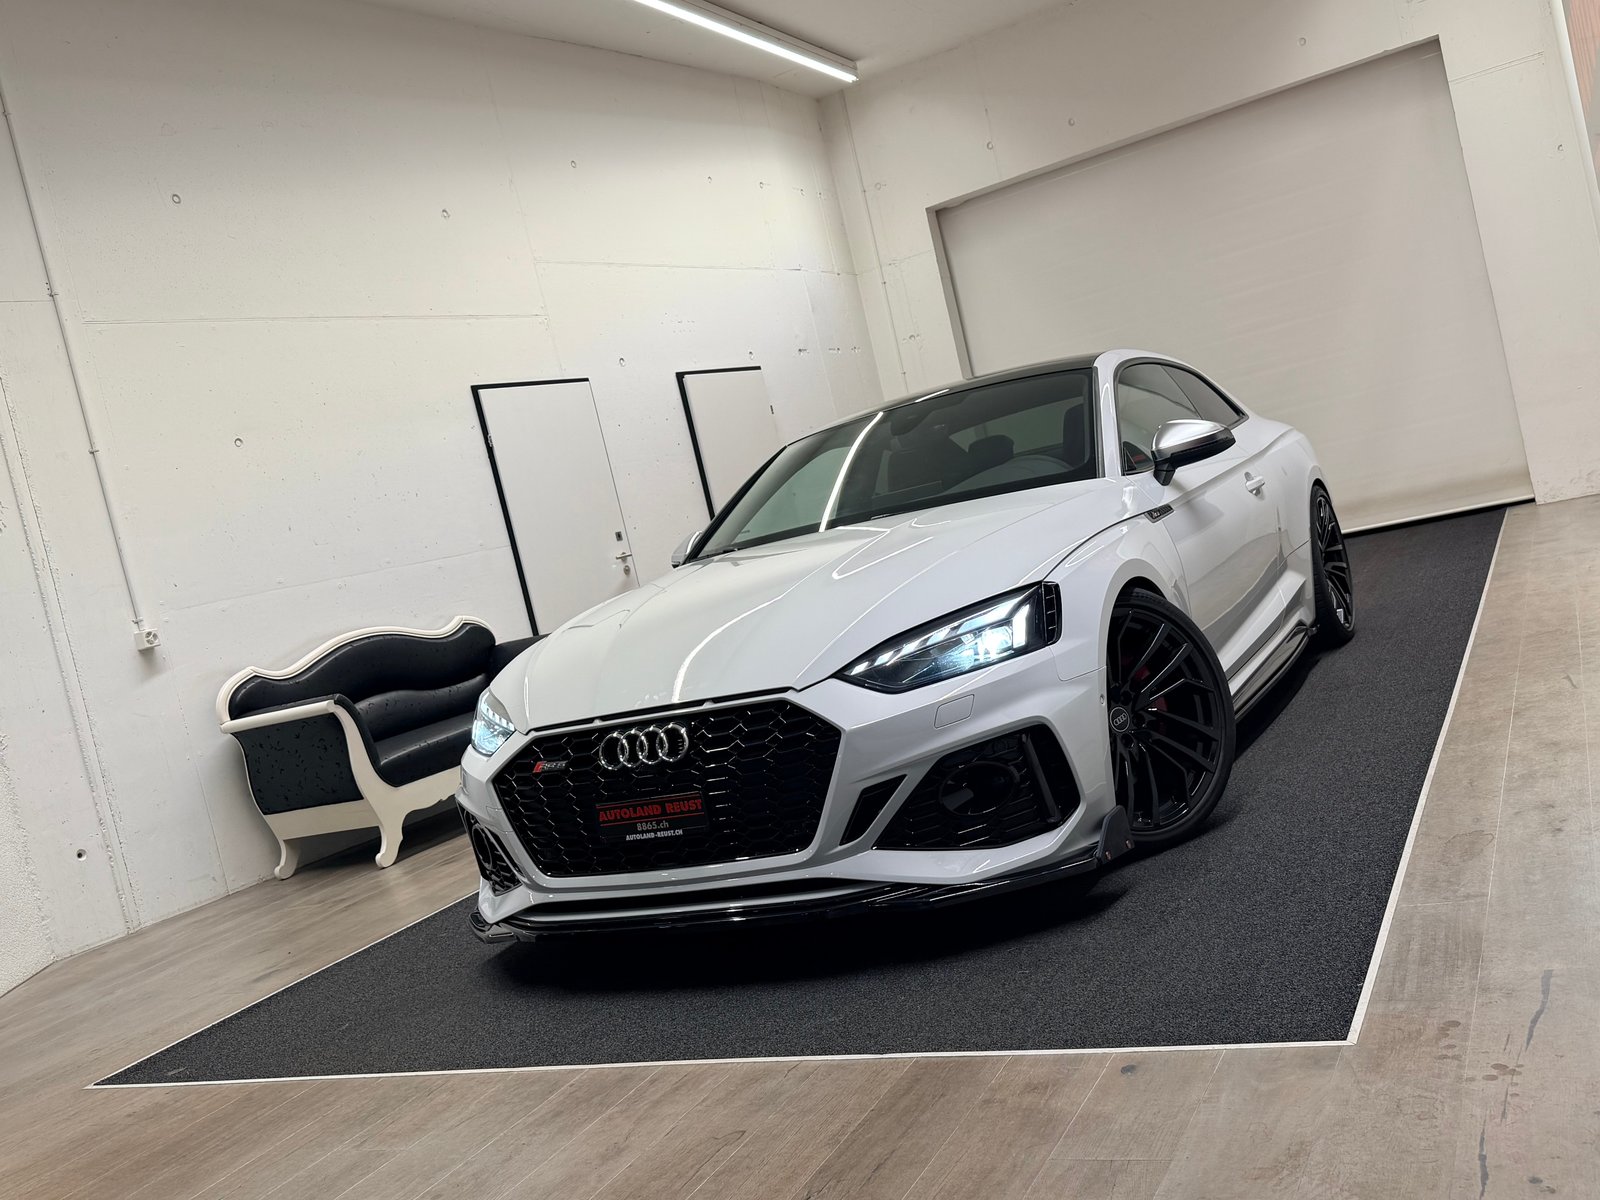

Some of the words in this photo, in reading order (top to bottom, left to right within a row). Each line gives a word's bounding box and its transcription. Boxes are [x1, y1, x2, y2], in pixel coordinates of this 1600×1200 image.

[600, 804, 662, 821] AUTOLAND
[665, 799, 703, 813] REUST
[636, 820, 669, 831] 8865.ch
[625, 829, 683, 841] AUTOLAND-REUST.CH
